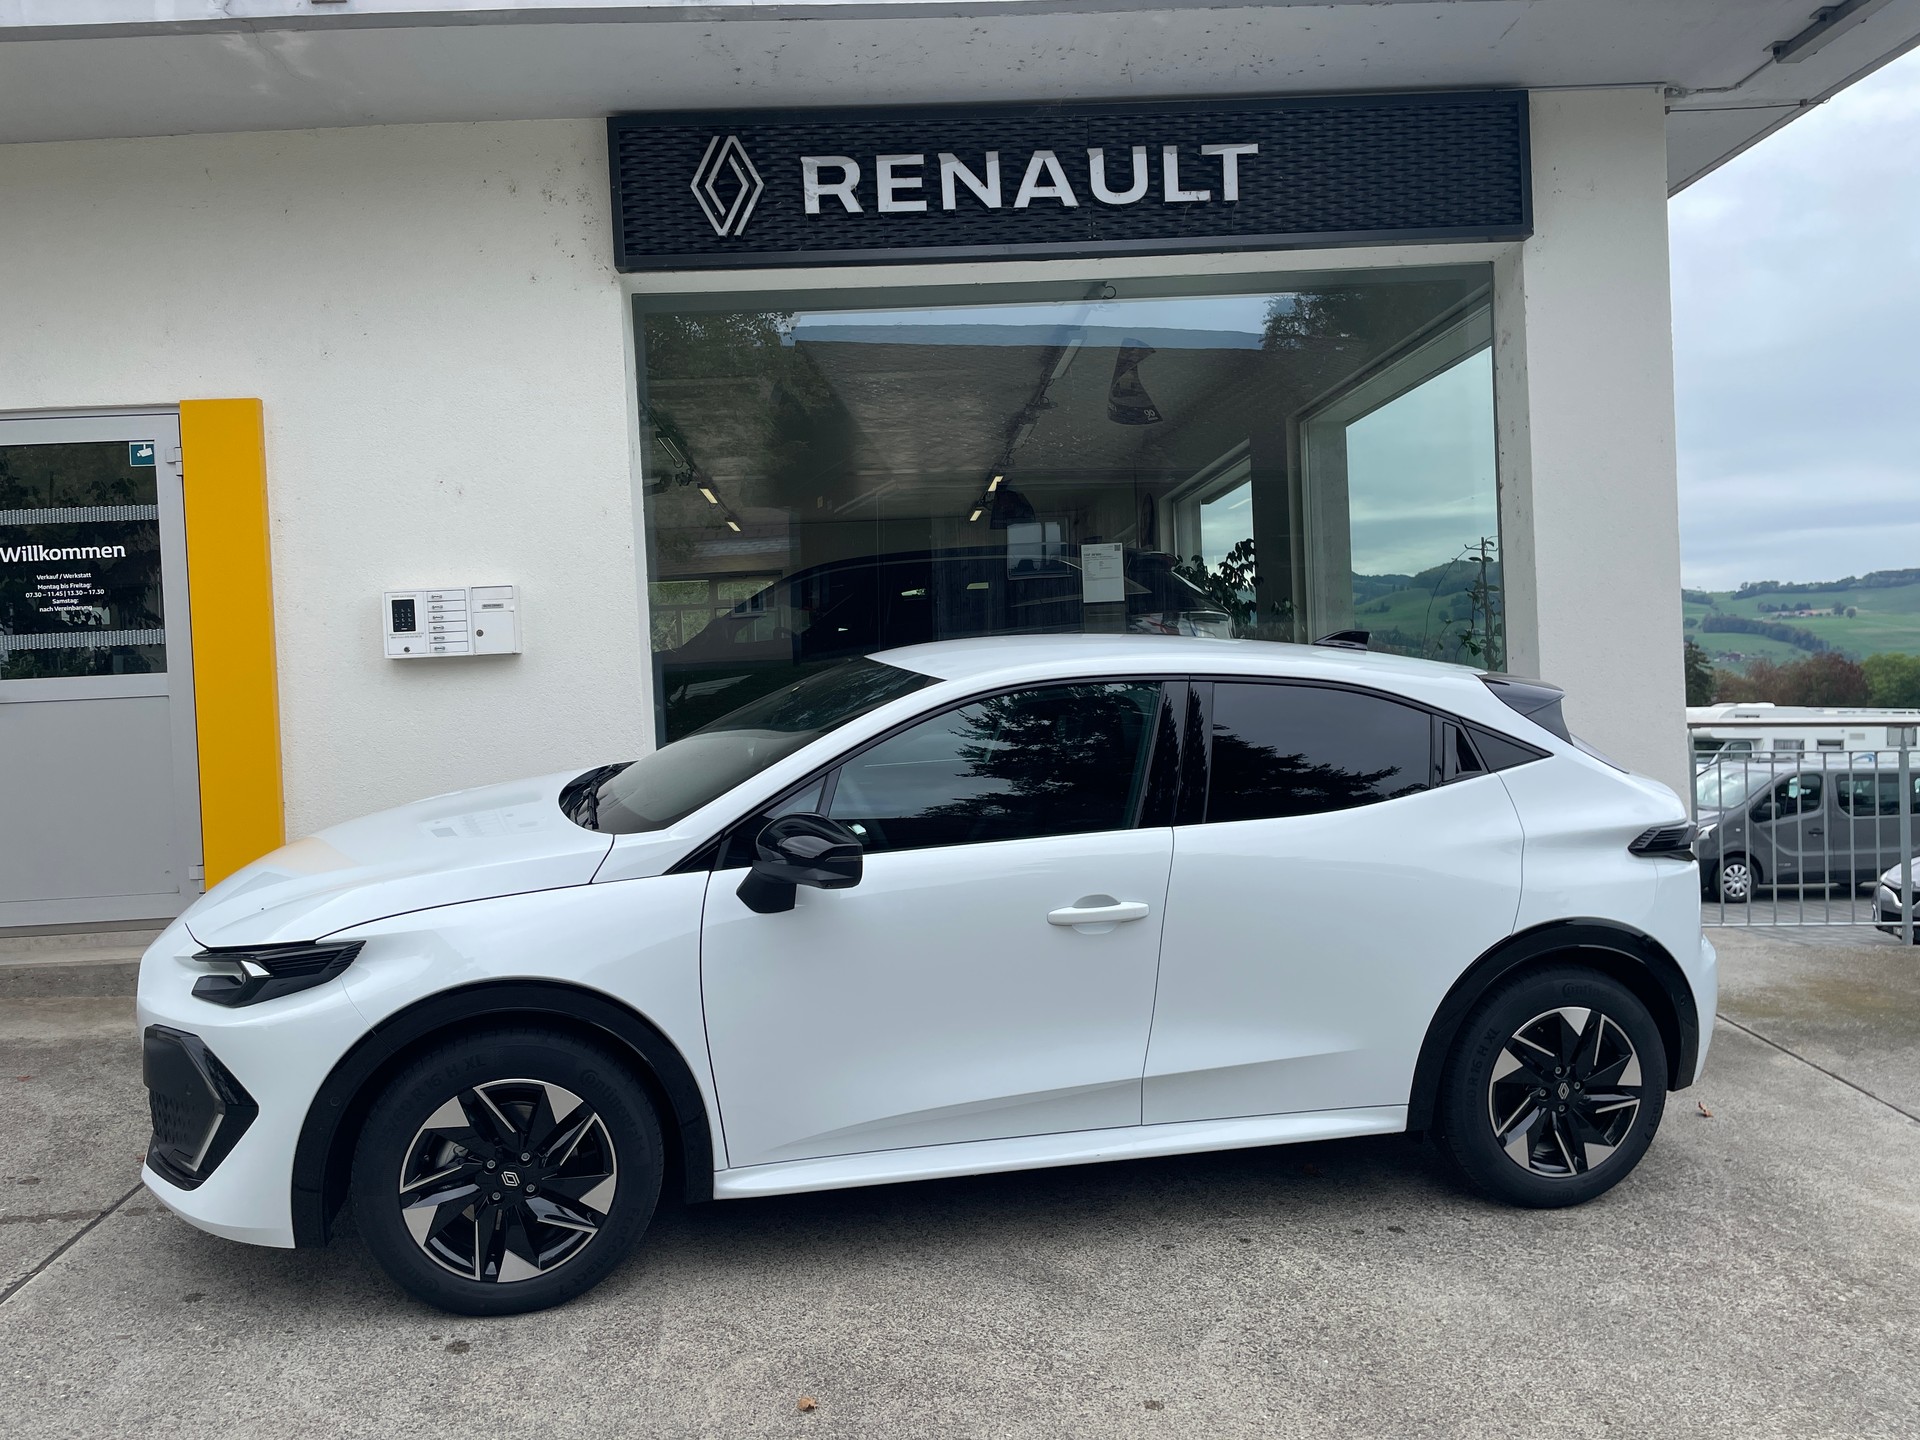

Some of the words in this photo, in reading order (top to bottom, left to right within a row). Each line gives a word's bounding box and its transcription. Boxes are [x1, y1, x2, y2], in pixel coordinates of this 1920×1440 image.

[800, 143, 1259, 214] RENAULT
[0, 545, 126, 562] Willkommen
[63, 572, 92, 580] Werkstatt
[70, 582, 92, 590] Freitag:
[54, 604, 93, 612] Vereinbarung
[1471, 1058, 1483, 1074] 16
[1477, 1045, 1489, 1057] H
[1484, 1028, 1501, 1045] XL
[424, 1073, 442, 1090] 16
[445, 1064, 460, 1078] H
[463, 1055, 487, 1071] XL
